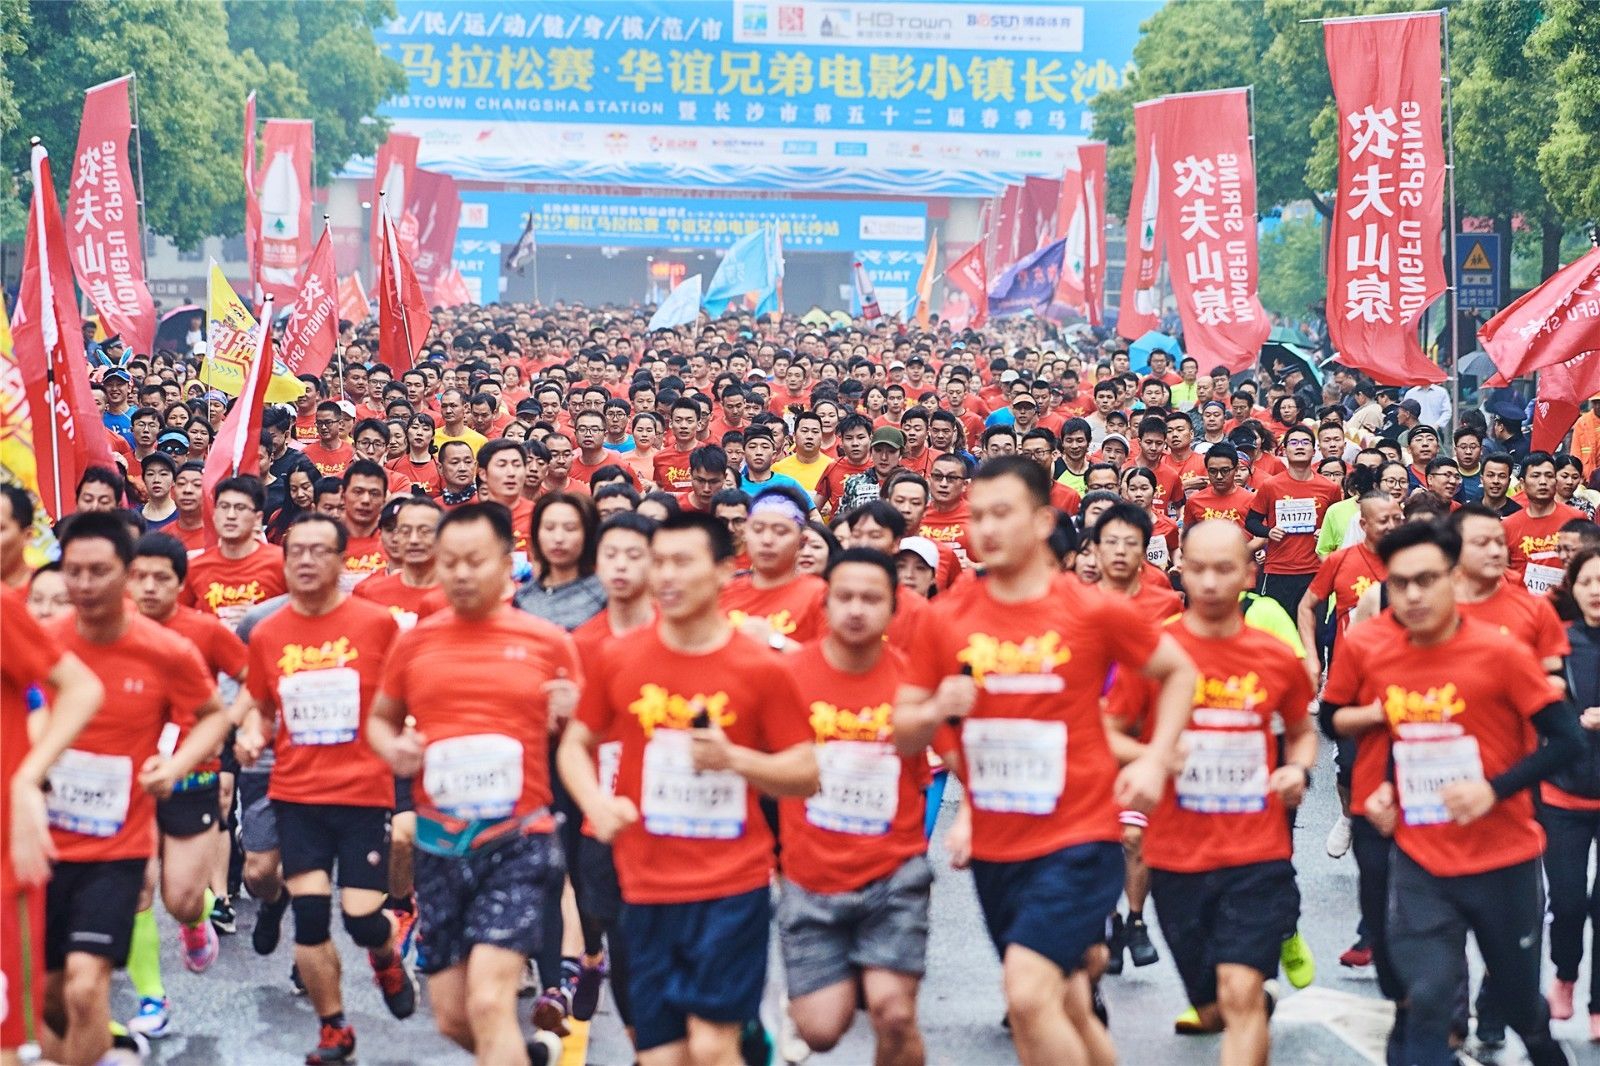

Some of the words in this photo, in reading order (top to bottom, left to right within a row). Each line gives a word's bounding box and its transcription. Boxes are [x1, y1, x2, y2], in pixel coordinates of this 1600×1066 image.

[474, 96, 580, 113] CHANGSHA
[584, 100, 664, 115] STATION
[1280, 512, 1313, 522] A11777
